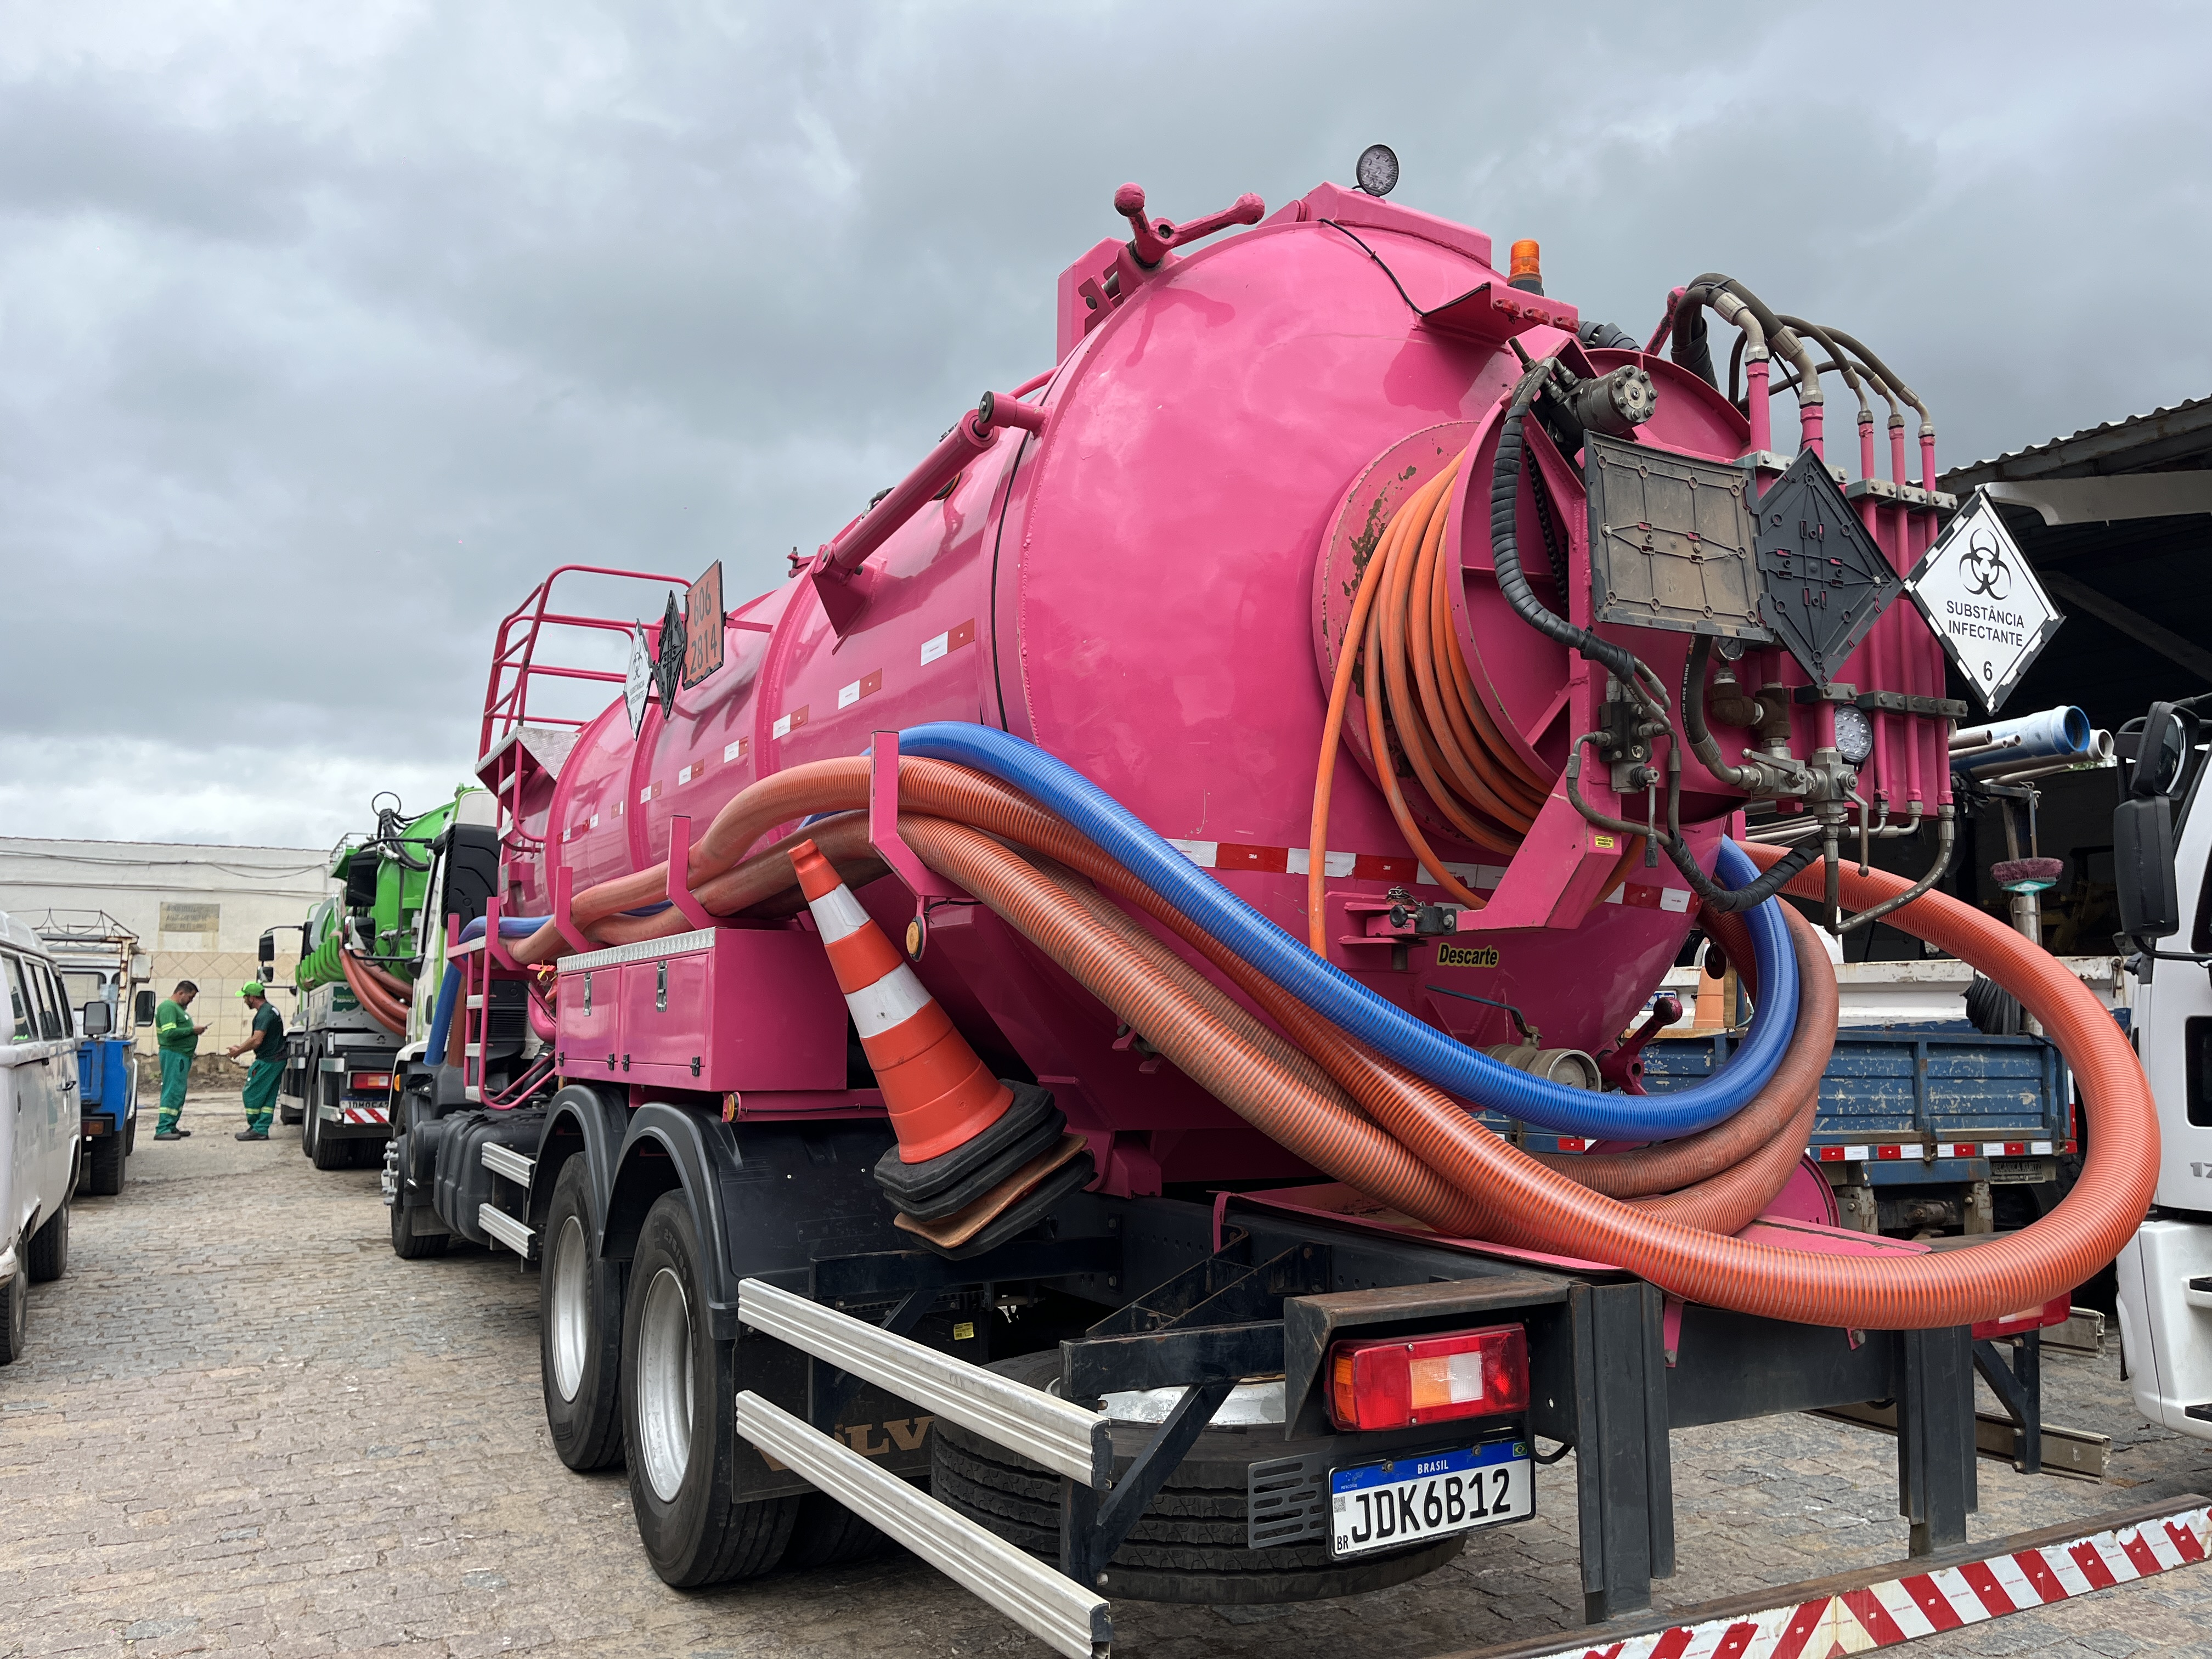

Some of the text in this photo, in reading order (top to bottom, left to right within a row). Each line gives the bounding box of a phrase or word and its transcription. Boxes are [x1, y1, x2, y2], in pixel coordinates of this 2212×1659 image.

[694, 580, 712, 627] 606
[1946, 600, 2025, 629] SUBSTÂNCIA
[1948, 619, 2023, 647] INFECTANTE
[690, 623, 718, 675] 2814
[1983, 661, 1993, 681] 6
[1438, 944, 1498, 966] Descarte
[1417, 1459, 1449, 1474] BRASIL
[1351, 1468, 1510, 1543] JDK6B12
[1337, 1534, 1348, 1550] BR
[1796, 1626, 1804, 1634] 3M
